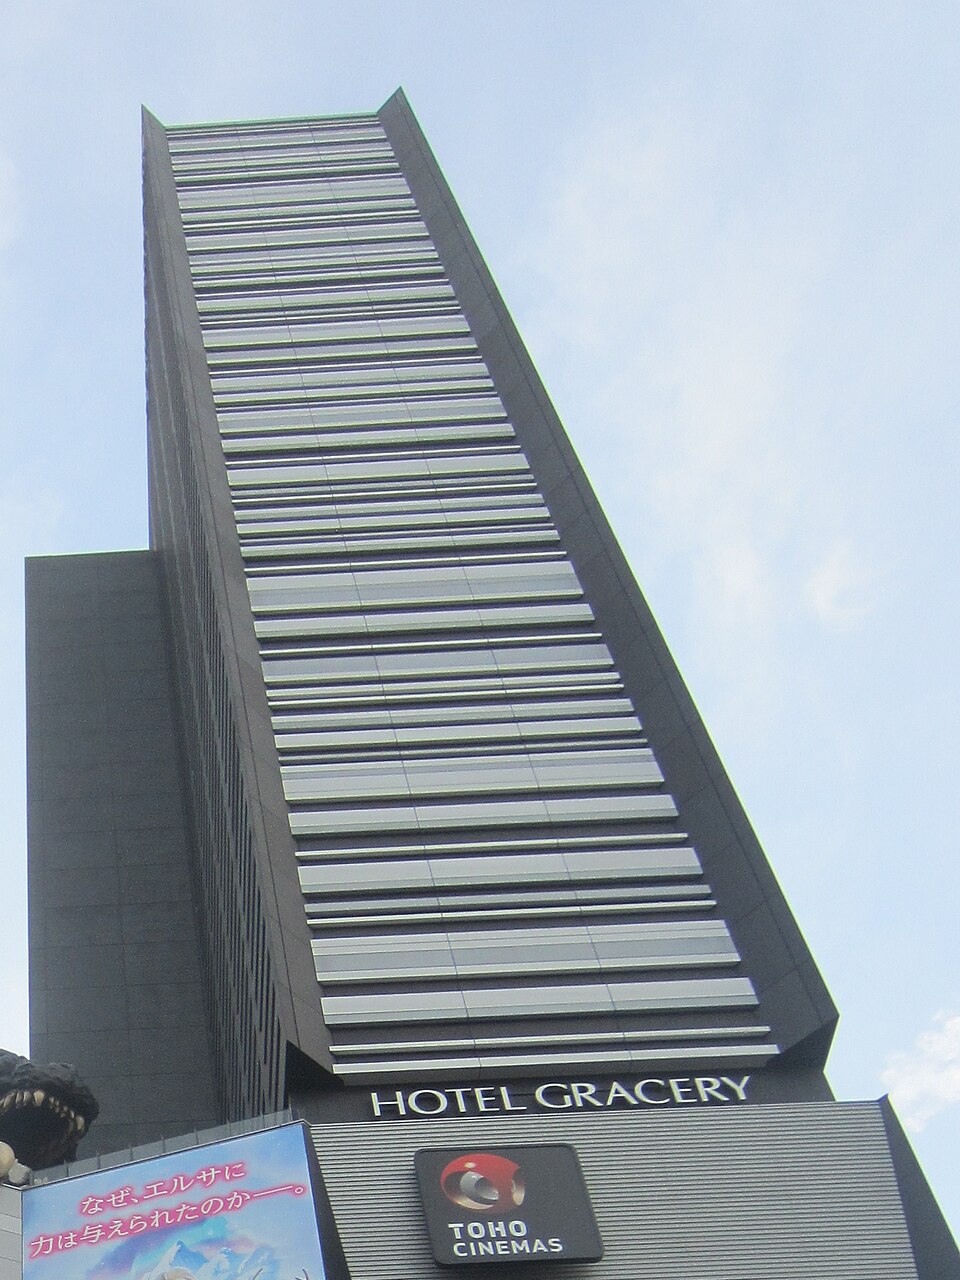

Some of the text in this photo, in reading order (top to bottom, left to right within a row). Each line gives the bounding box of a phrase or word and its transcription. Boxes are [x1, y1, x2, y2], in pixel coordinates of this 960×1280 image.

[371, 1076, 751, 1116] HOTEL GRACERY
[82, 1162, 246, 1214] なぜ、エルサに
[448, 1220, 527, 1239] TOHO
[453, 1238, 563, 1257] CINEMAS
